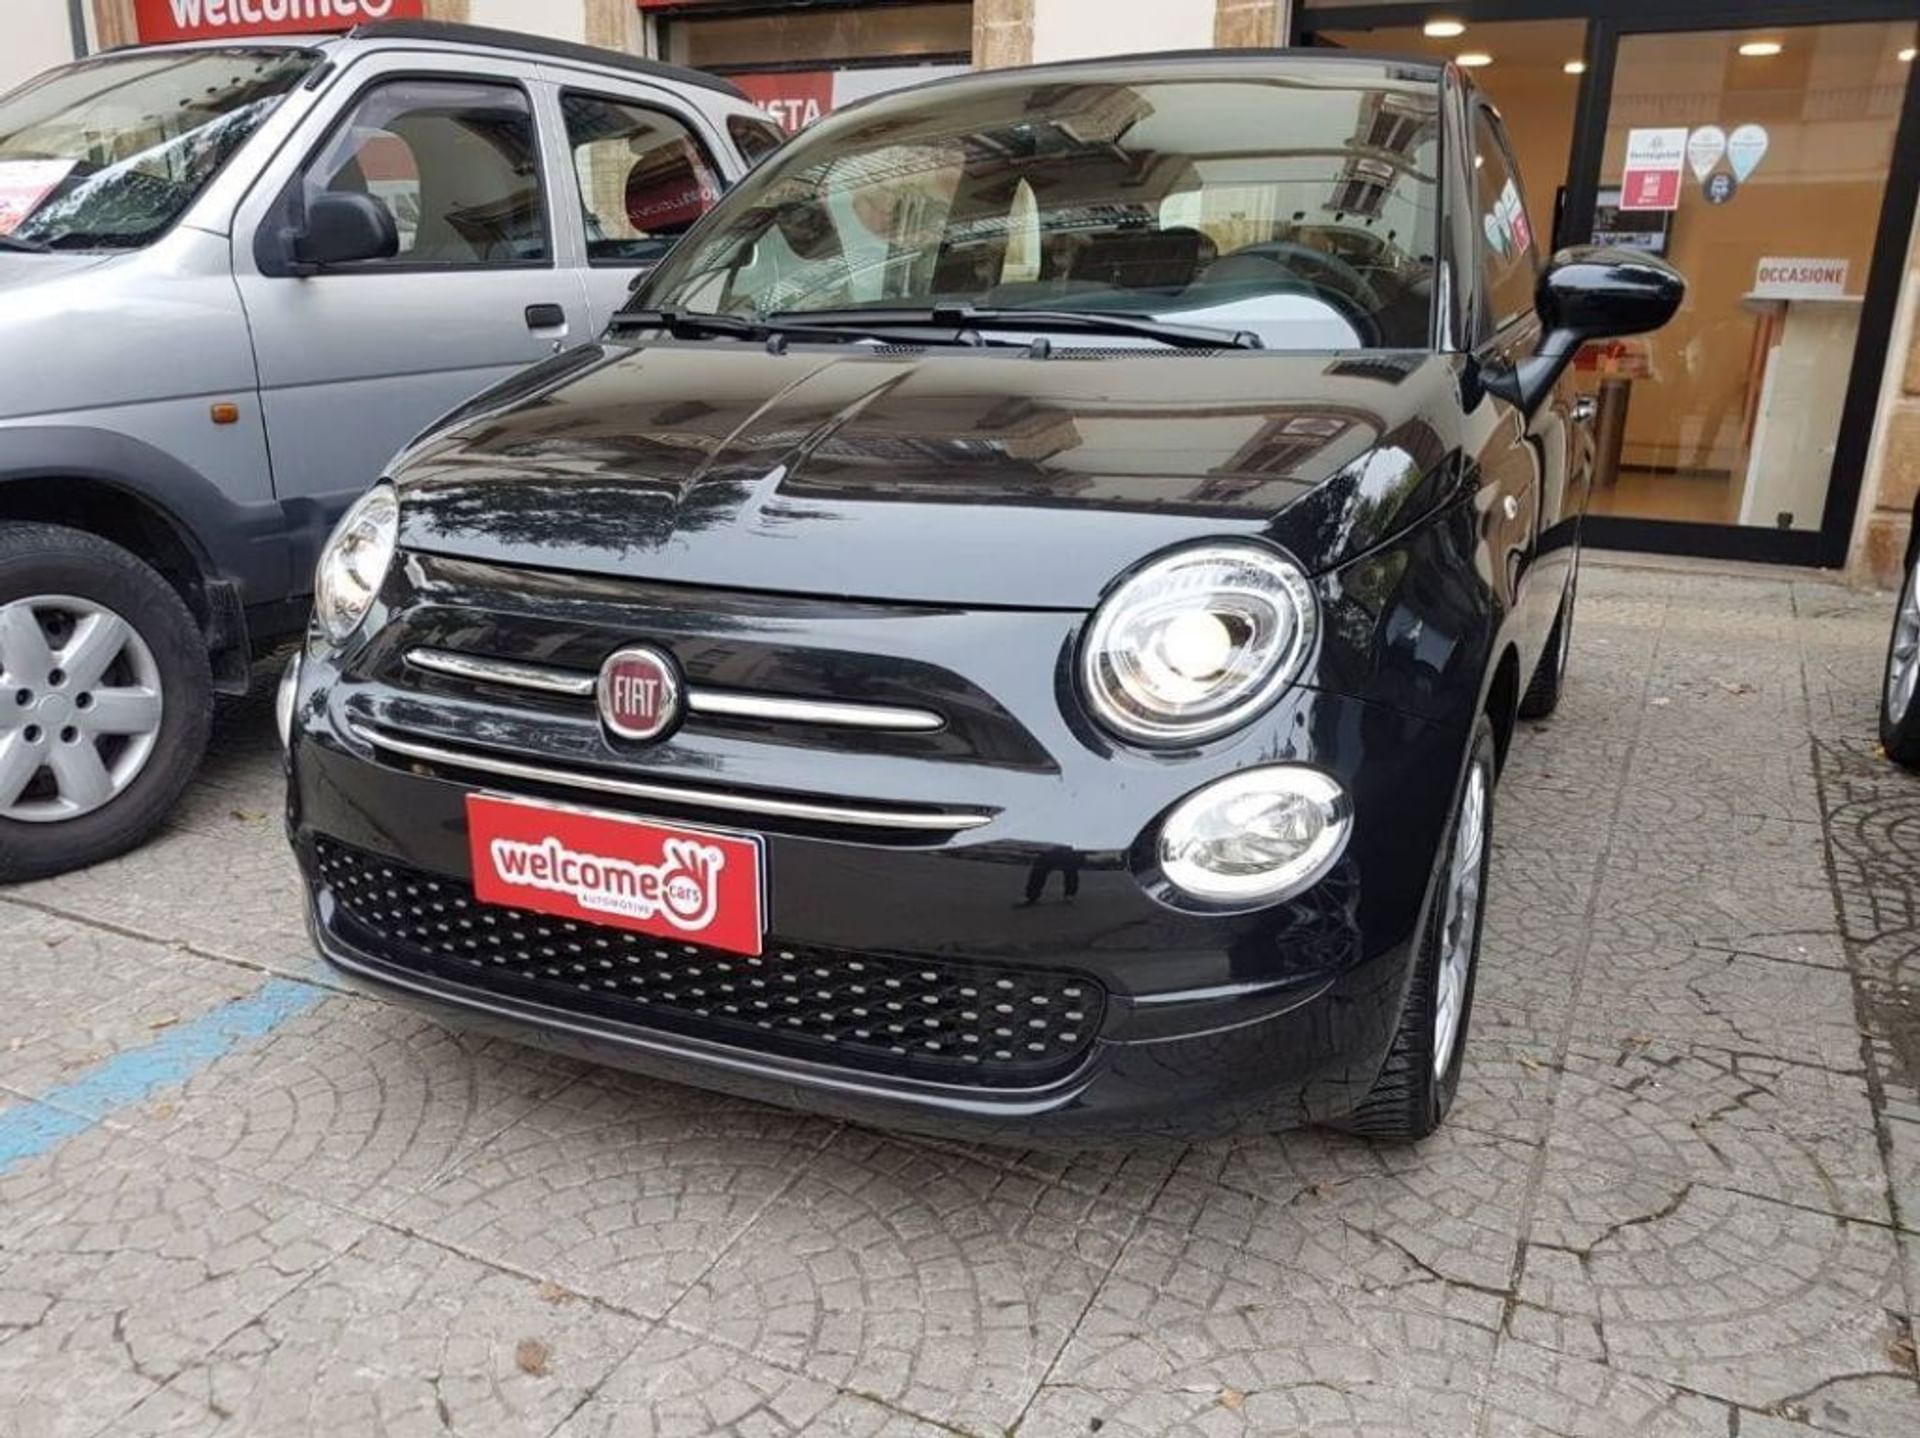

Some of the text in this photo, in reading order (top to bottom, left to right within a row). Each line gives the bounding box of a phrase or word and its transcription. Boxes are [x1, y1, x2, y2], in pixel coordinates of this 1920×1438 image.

[1760, 267, 1844, 283] OCCASIONE
[615, 675, 659, 718] FIAT
[499, 845, 700, 903] welcome cars
[582, 893, 650, 914] AUTOMOTIVE
